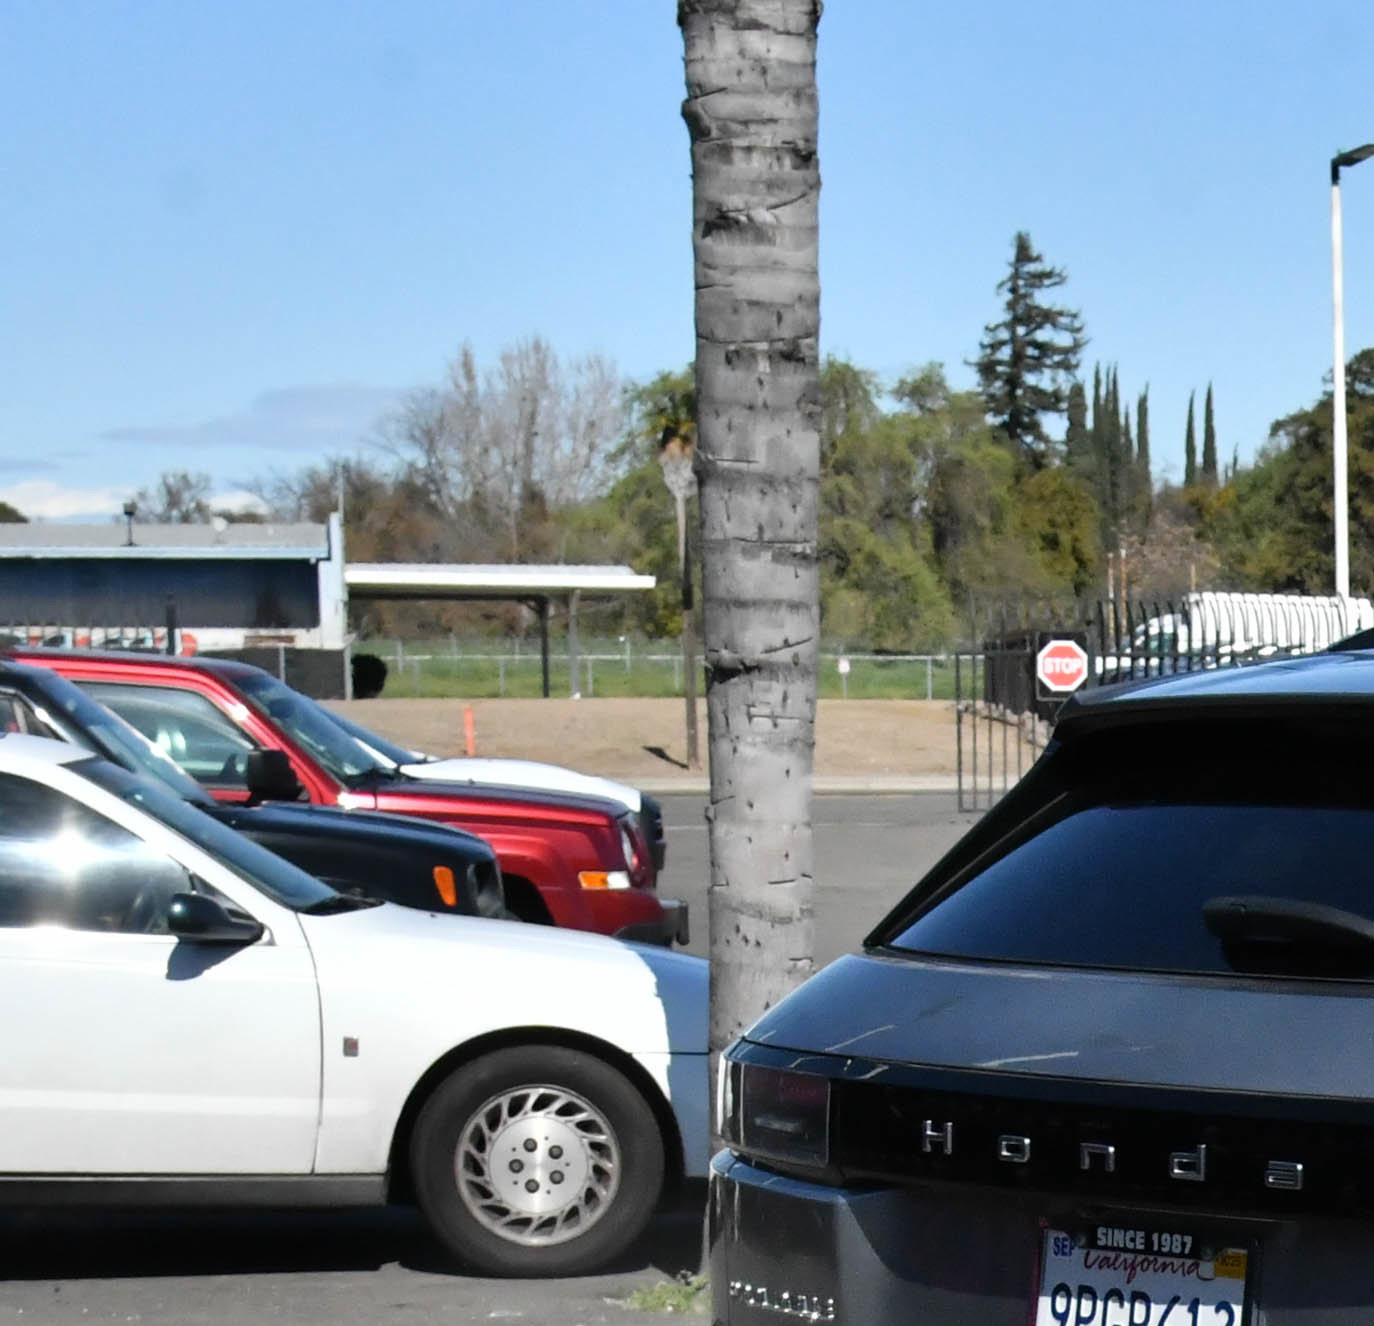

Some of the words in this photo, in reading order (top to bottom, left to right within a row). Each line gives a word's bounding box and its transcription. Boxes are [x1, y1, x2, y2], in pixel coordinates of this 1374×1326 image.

[1043, 657, 1082, 675] STOP
[1096, 1226, 1145, 1250] SINCE
[1151, 1231, 1193, 1254] 1987
